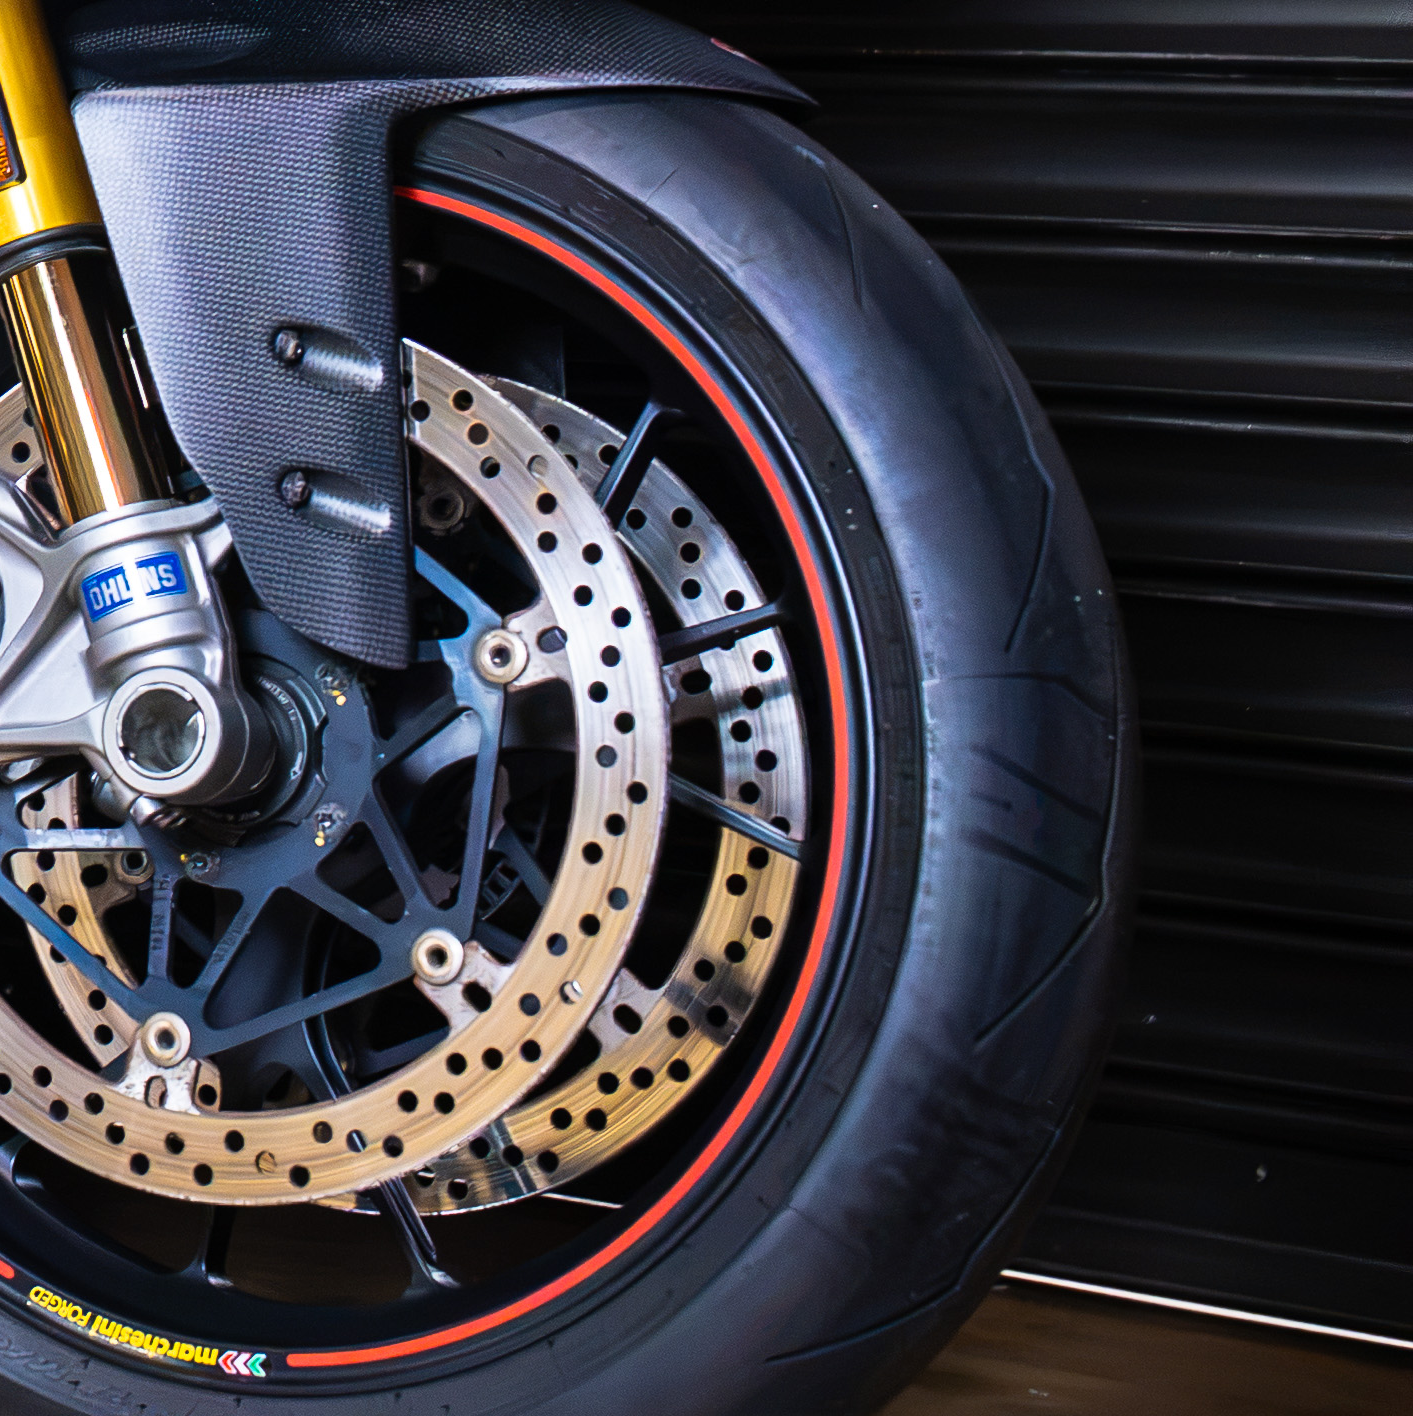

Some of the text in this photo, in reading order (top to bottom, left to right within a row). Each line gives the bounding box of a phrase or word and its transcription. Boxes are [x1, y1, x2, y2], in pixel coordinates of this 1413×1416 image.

[87, 564, 177, 611] ÖHLNS
[28, 1285, 90, 1327] FORGED
[90, 1315, 219, 1366] marchesini
